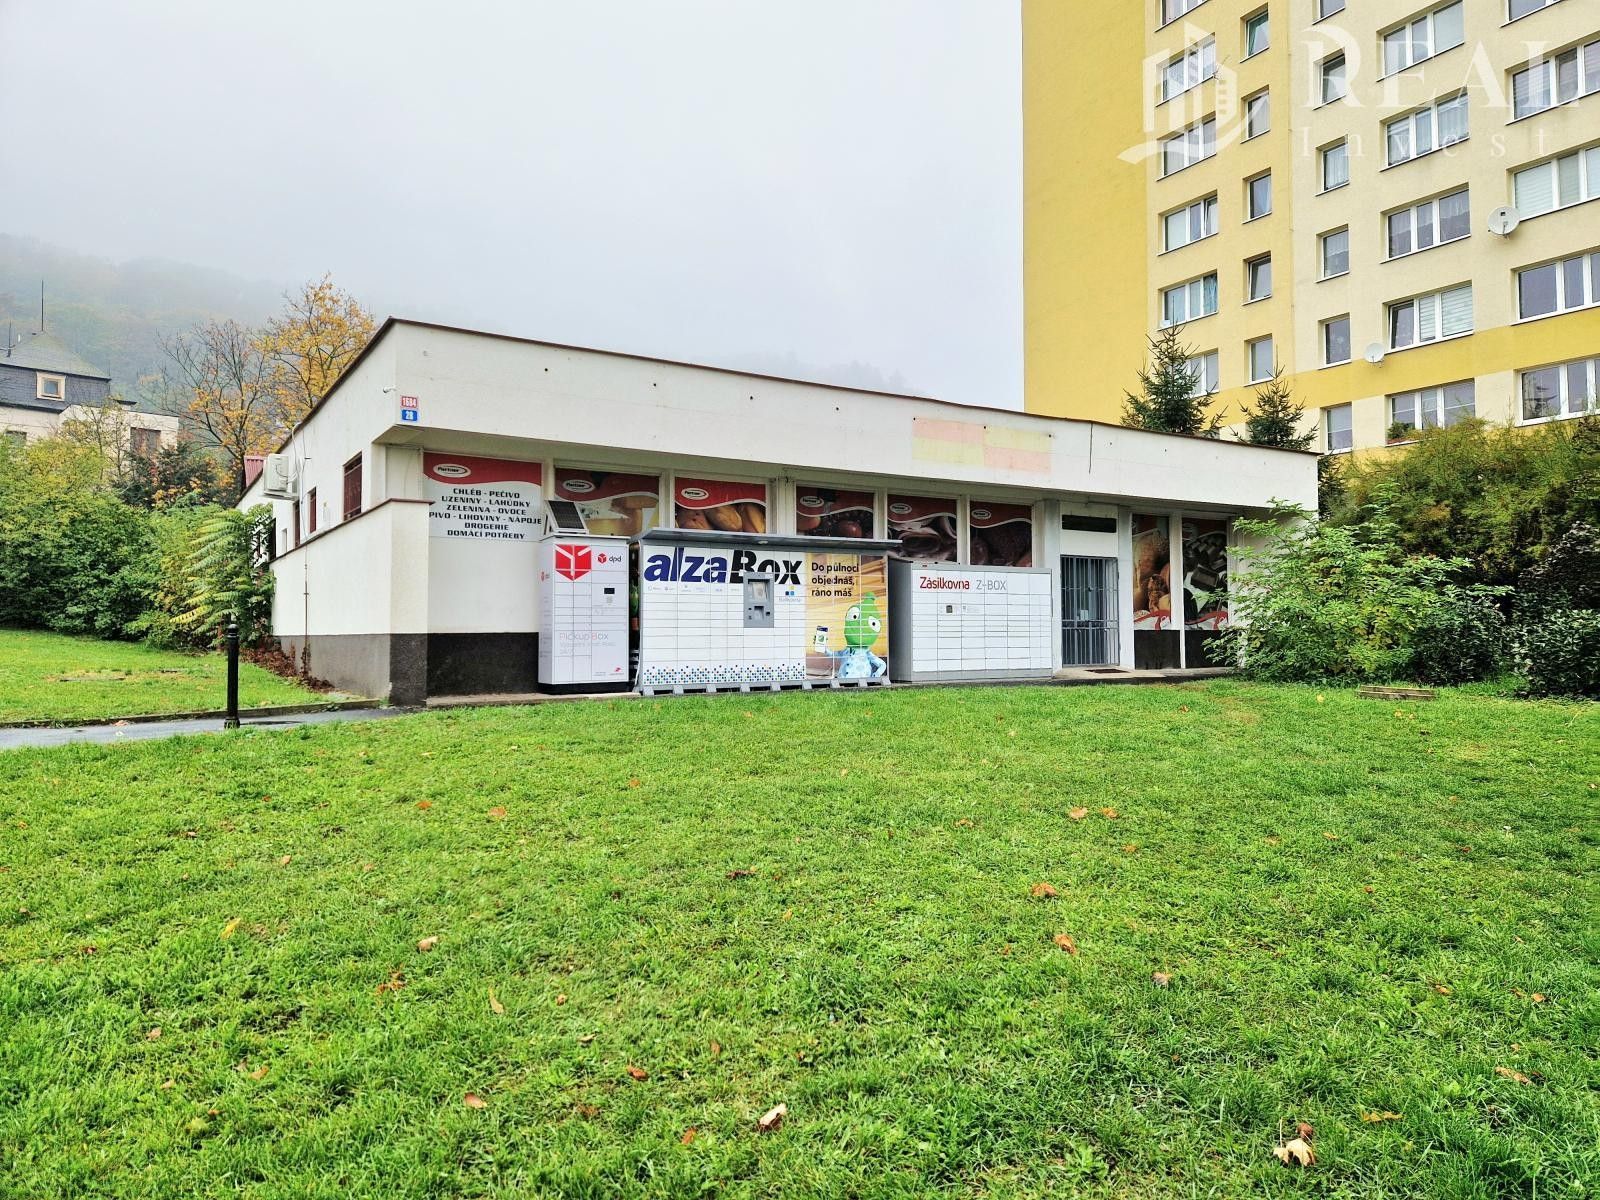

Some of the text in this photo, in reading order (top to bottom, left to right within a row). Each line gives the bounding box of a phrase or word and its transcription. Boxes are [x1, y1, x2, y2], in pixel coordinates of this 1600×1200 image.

[453, 488, 482, 496] CHLÉB
[489, 490, 520, 499] PEČIVO
[441, 496, 482, 504] UZENINY
[446, 504, 491, 513] ZELENINA
[498, 507, 527, 516] OVOCE
[459, 514, 501, 522] LIHOVINY
[508, 516, 542, 525] NÁPOJE
[464, 522, 509, 530] DROGERIE
[447, 529, 483, 538] DOMÁCÍ
[609, 555, 622, 564] dpd
[643, 547, 803, 585] alzaBox
[811, 562, 825, 571] Do
[811, 575, 855, 586] objednáš,
[919, 576, 1007, 591] Zásilkovna Z-BOX
[811, 587, 852, 597] ráno máš
